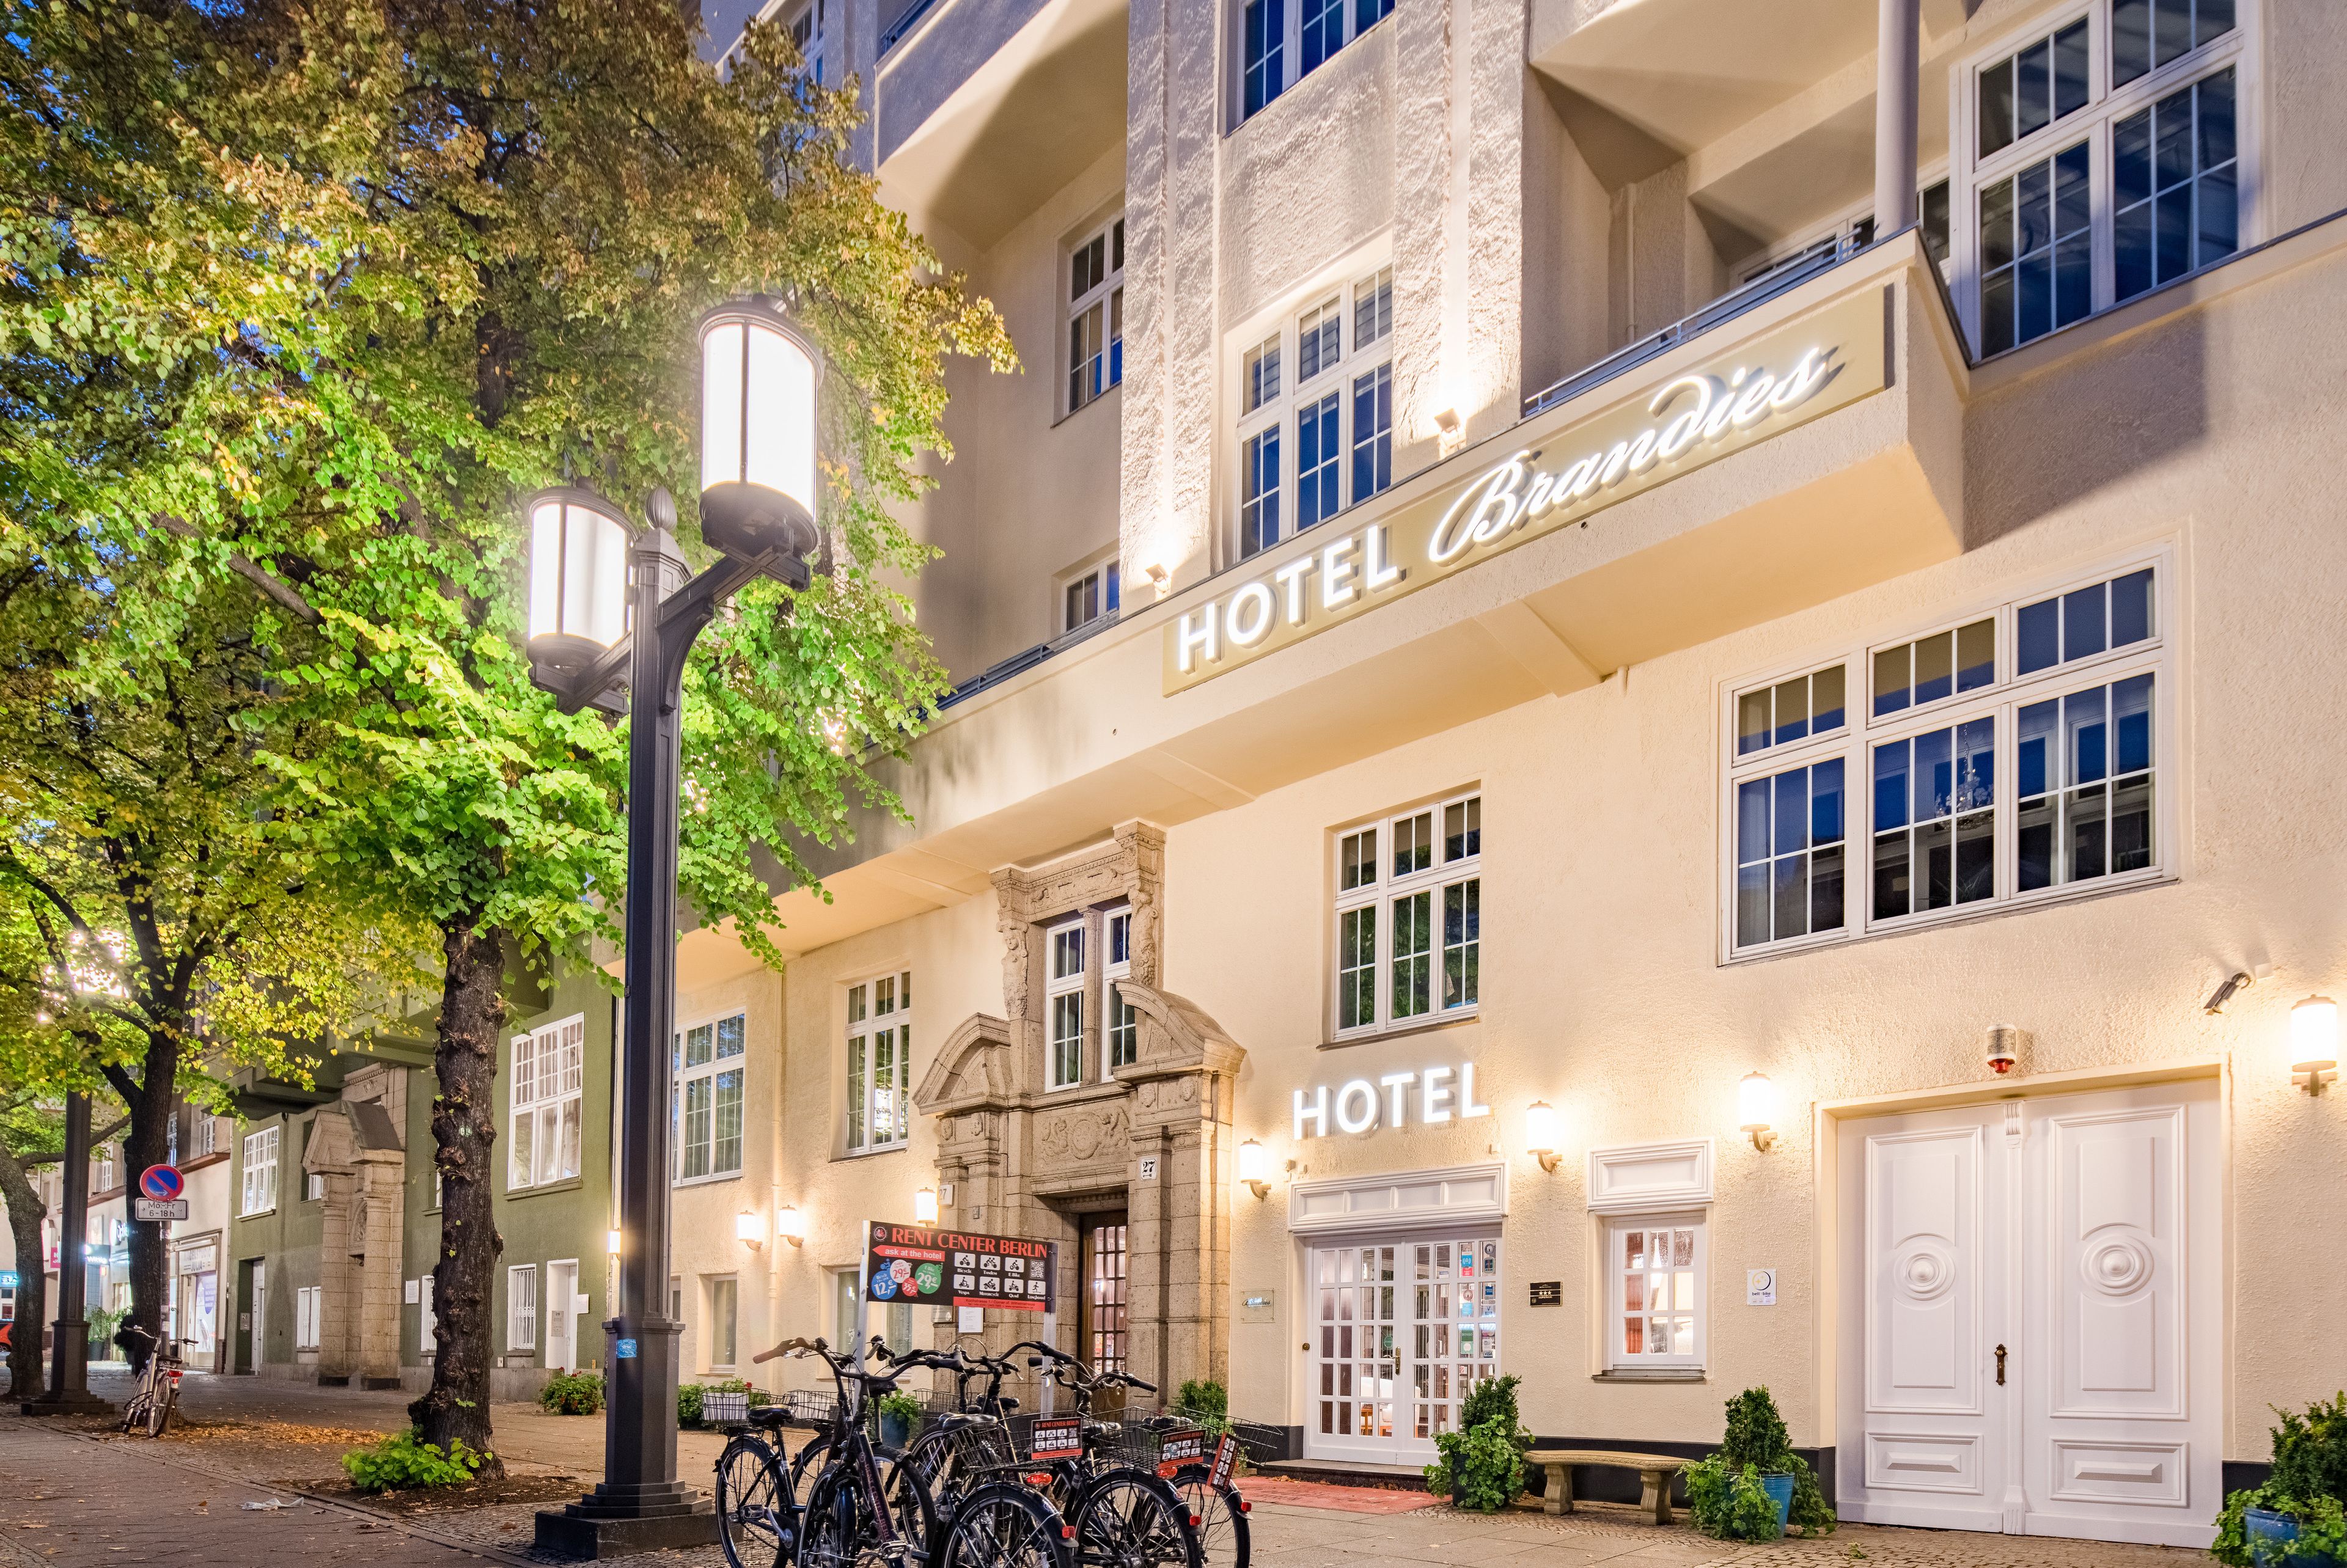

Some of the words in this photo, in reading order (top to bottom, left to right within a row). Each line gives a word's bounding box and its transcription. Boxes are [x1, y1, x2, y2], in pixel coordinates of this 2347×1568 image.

[1178, 524, 1400, 672] HOTEL
[1428, 346, 1827, 564] Brandies
[1293, 1062, 1490, 1140] HOTEL
[1142, 1160, 1155, 1173] 27
[939, 1188, 947, 1200] 27
[892, 1227, 934, 1246] RENT
[938, 1233, 996, 1253] CENTER
[999, 1239, 1047, 1258] BERLIN
